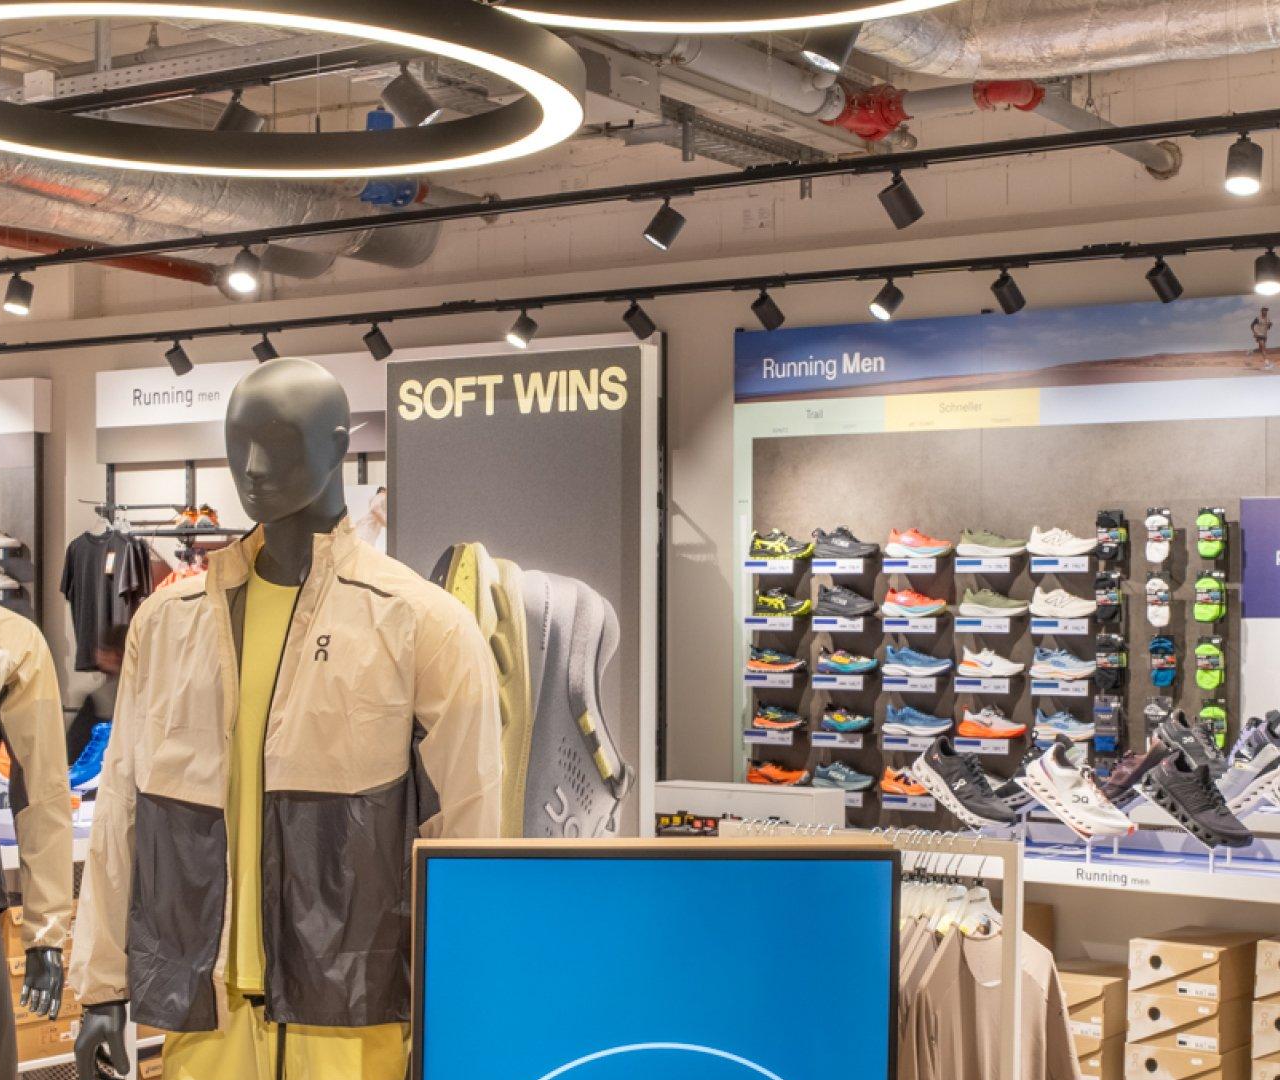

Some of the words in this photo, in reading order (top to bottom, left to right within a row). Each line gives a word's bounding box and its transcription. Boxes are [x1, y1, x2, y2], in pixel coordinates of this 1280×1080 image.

[762, 355, 838, 380] Running
[843, 352, 885, 374] Men
[132, 386, 194, 408] Running
[198, 390, 221, 401] men
[398, 374, 504, 421] SOFT
[513, 366, 628, 414] WINS
[806, 408, 823, 419] Trail
[938, 401, 982, 415] Schneller
[1076, 867, 1128, 887] Running
[1131, 877, 1151, 886] men
